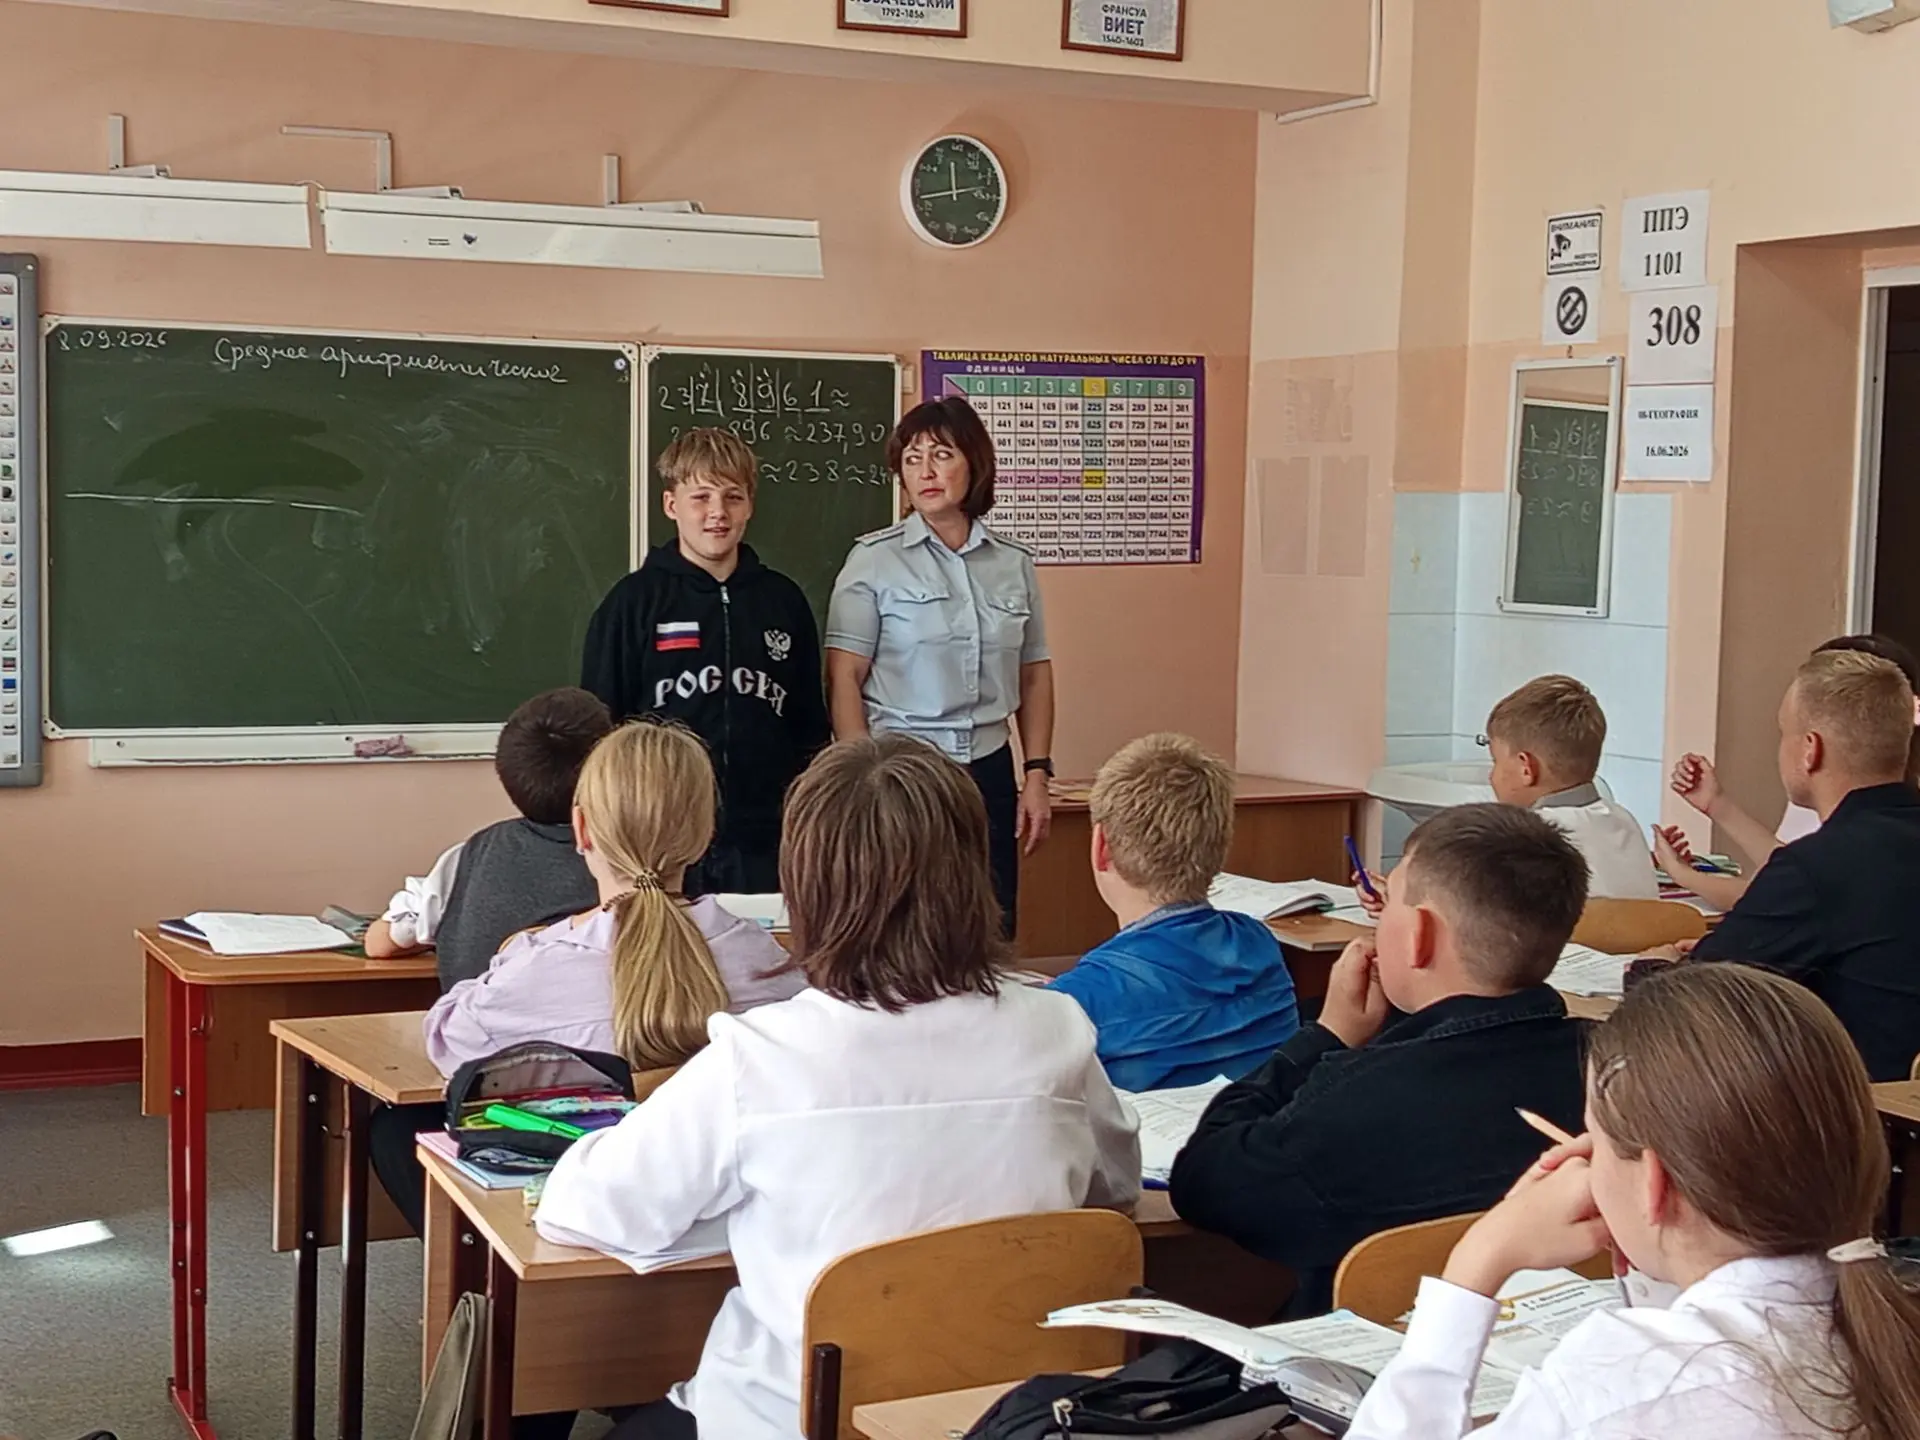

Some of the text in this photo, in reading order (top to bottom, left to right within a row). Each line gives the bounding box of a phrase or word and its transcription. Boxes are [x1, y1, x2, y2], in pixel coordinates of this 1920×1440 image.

[1102, 4, 1147, 17] ФРАНСУА
[1104, 16, 1145, 35] ВИЕТ
[1643, 206, 1689, 233] ППЭ
[1644, 252, 1682, 277] 1101
[1647, 304, 1701, 347] 308
[214, 337, 308, 370] Среднее
[932, 351, 979, 361] ТАБЛИЦА
[980, 352, 1037, 362] КВАДРАТОВ
[1040, 354, 1109, 364] НАТУРАЛЬНЫХ
[1112, 355, 1144, 364] ЧИСЕЛ
[1145, 355, 1157, 364] ОТ
[1170, 356, 1184, 366] ДО
[976, 381, 985, 393] 0
[1001, 381, 1008, 393] 1
[1023, 381, 1032, 393] 2
[1045, 381, 1054, 393] 3
[1067, 382, 1077, 393] 4
[1112, 383, 1121, 394] 6
[1135, 383, 1144, 394] 7
[1157, 383, 1165, 395] 8
[1178, 383, 1187, 395] 9
[997, 402, 1011, 410] 121
[1020, 402, 1034, 410] 144
[1087, 403, 1102, 411] 225
[997, 419, 1011, 428] 441
[786, 460, 840, 482] 238
[653, 665, 788, 717] РОССИЯ
